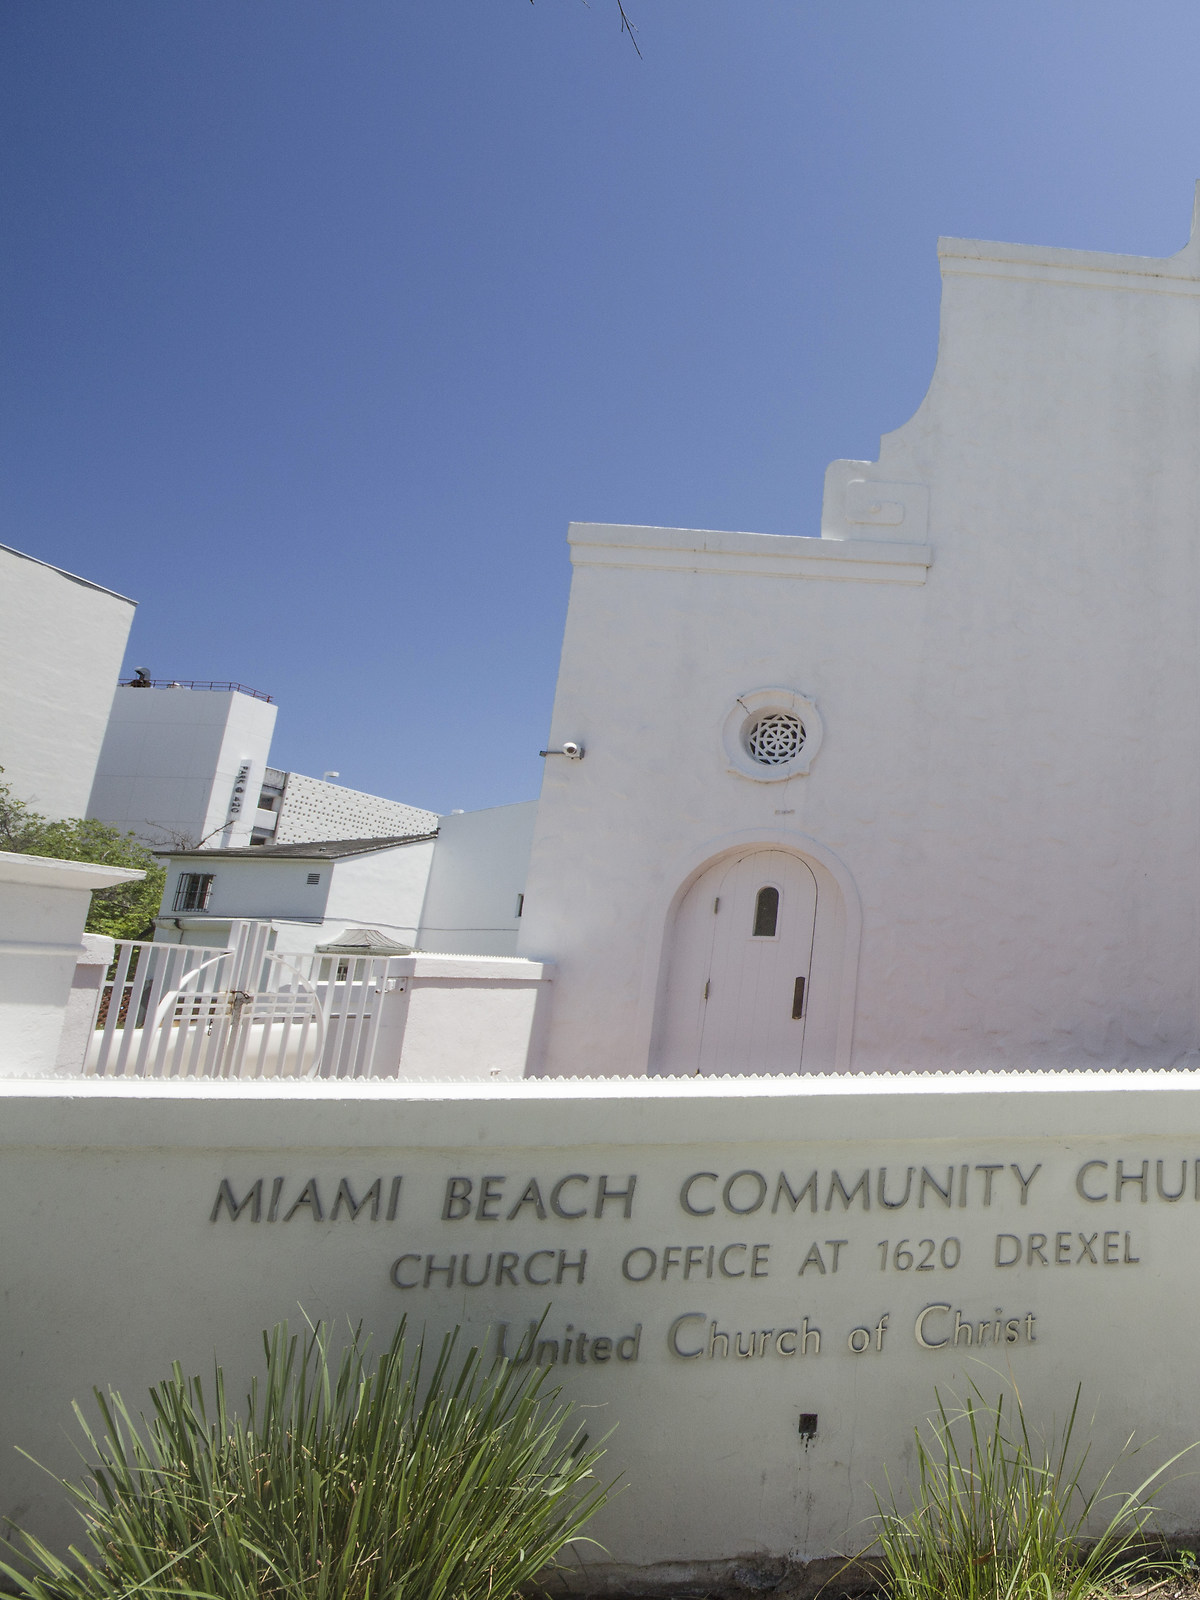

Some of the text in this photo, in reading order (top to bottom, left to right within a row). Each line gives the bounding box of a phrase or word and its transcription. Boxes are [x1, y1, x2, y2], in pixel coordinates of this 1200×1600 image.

[230, 796, 241, 813] 420
[209, 1175, 403, 1223] MIAMI
[441, 1173, 638, 1222] BEACH
[679, 1163, 1042, 1217] COMMUNITY
[389, 1230, 1141, 1289] CHURCH OFFICE AT 1620 DREXEL
[495, 1302, 1037, 1367] United Church of Christ
